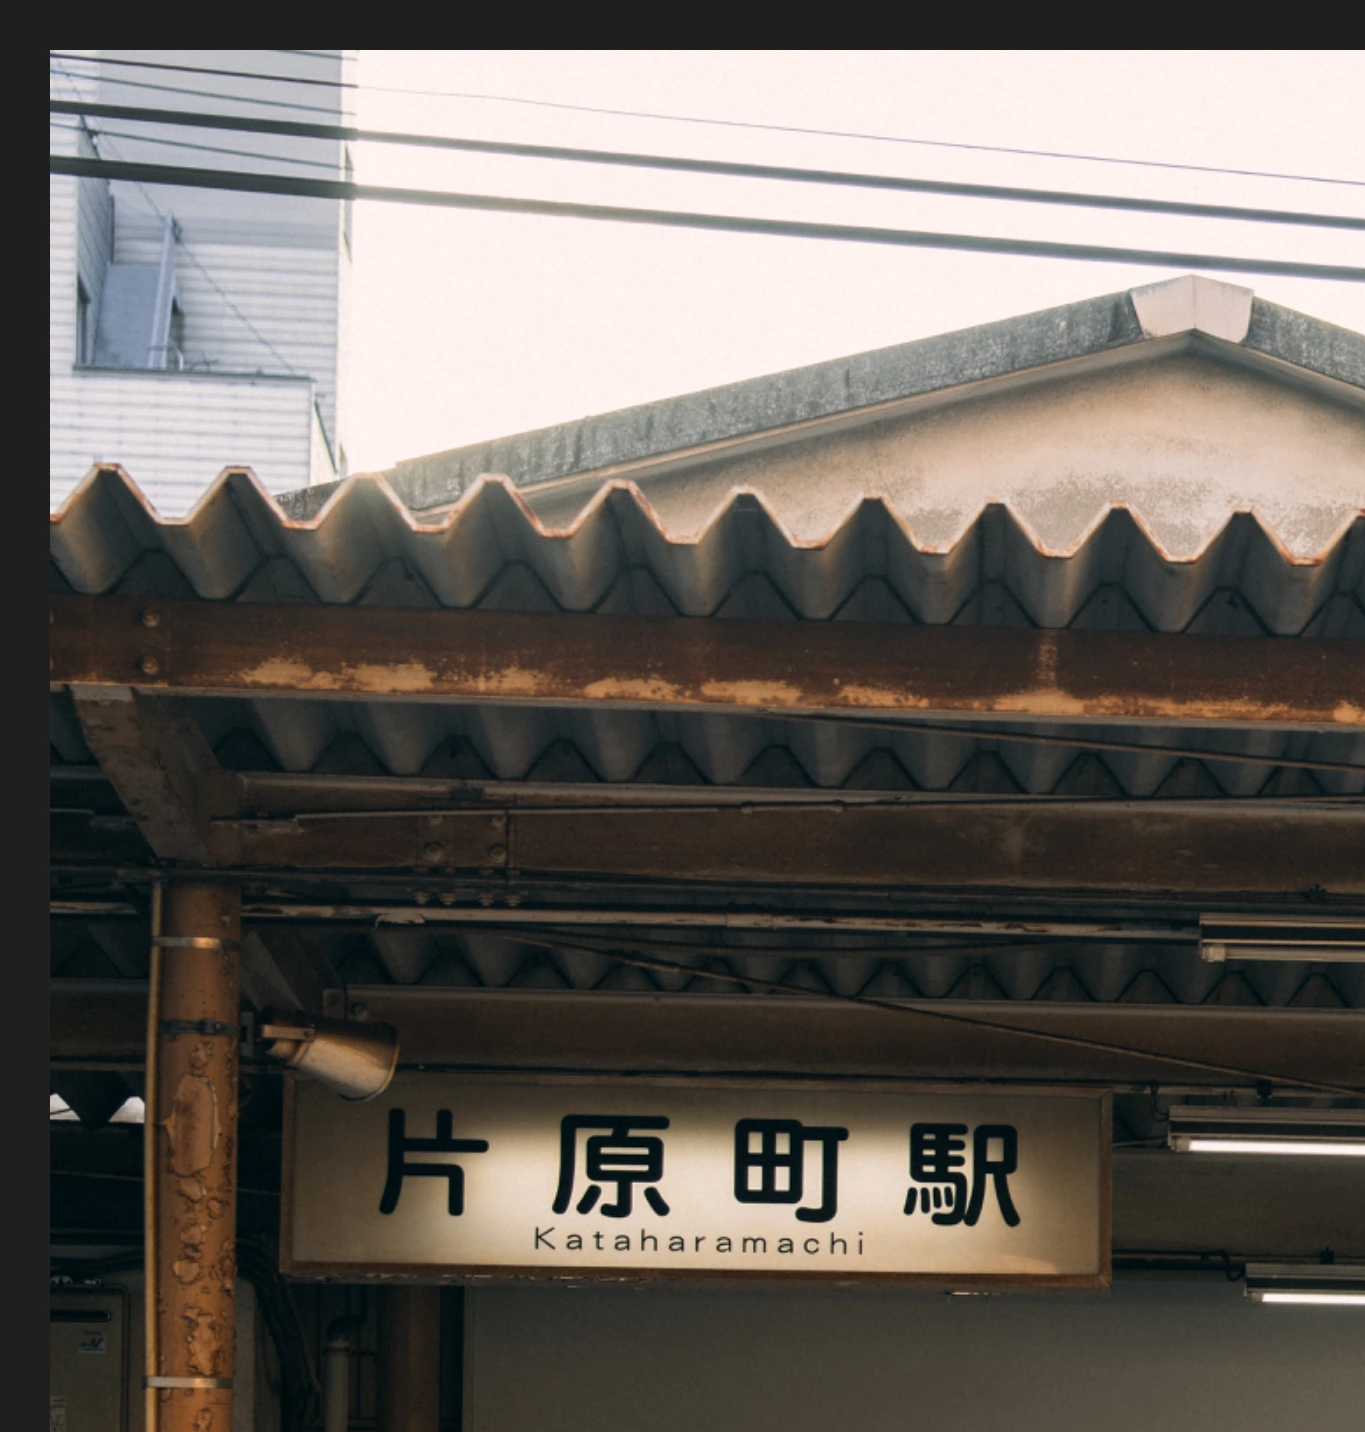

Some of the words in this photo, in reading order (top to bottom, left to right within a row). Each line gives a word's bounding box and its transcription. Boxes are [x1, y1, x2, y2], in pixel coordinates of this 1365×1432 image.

[378, 1107, 1021, 1228] 片原町駅
[533, 1226, 865, 1256] Kataharamachi
